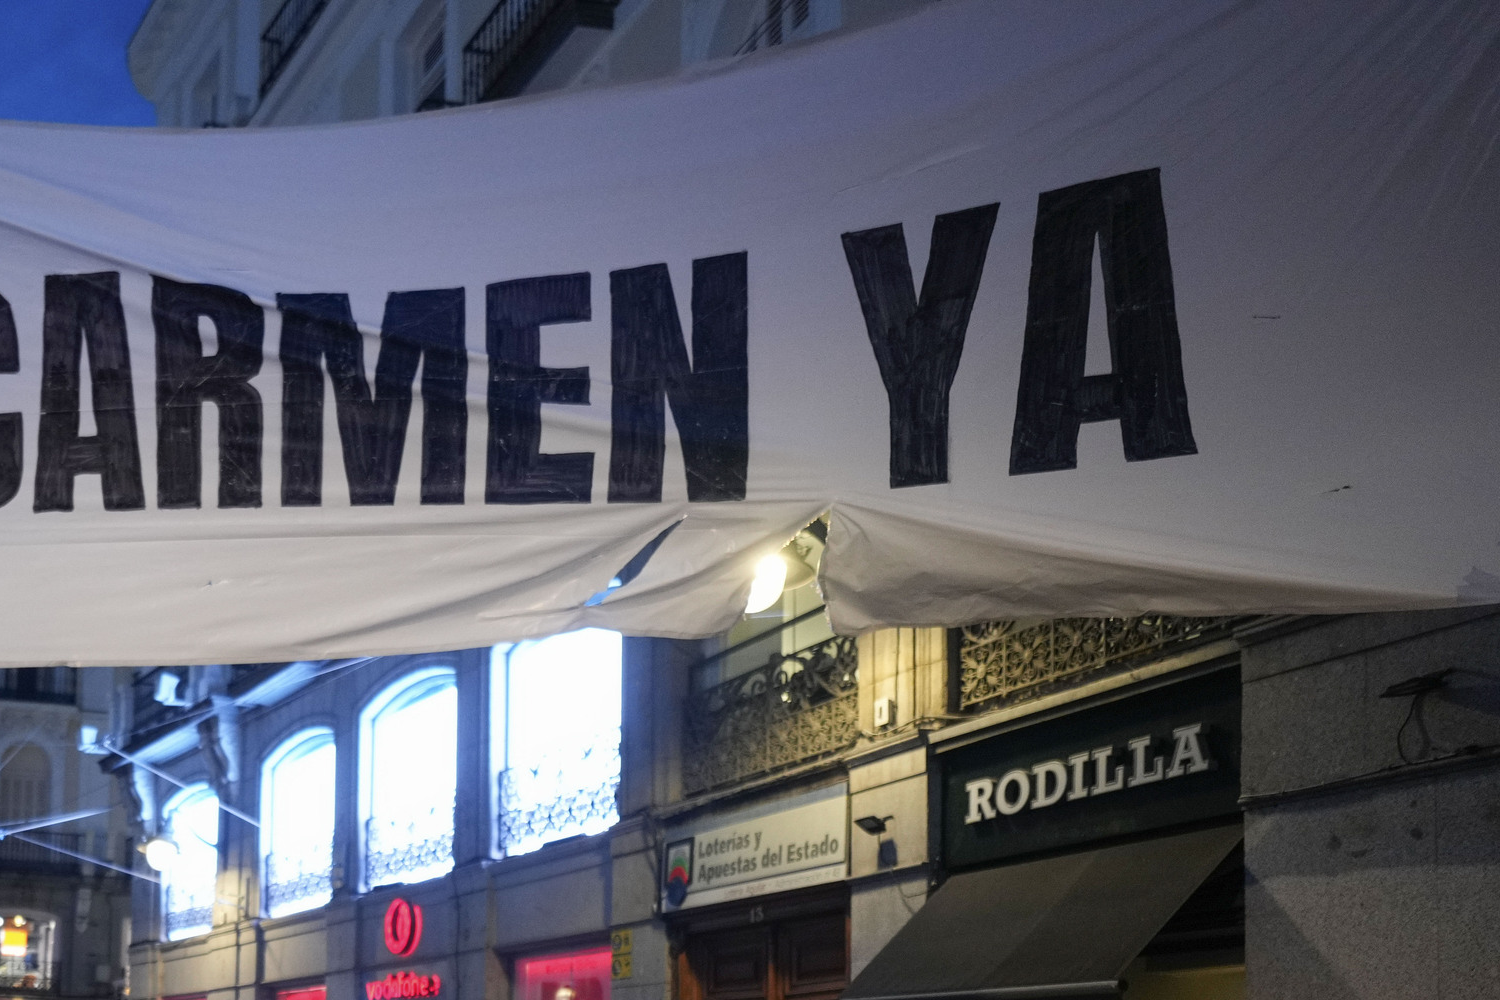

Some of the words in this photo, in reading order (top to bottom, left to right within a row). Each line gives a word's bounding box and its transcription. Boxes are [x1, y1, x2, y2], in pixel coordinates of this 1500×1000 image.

[841, 167, 1199, 489] YA
[964, 723, 1209, 825] RODILLA
[699, 832, 750, 859] Loterías
[754, 831, 763, 851] y
[699, 856, 758, 884] Apuestas
[761, 845, 783, 869] del
[787, 834, 840, 863] Estado
[365, 971, 429, 1000] vodafone
